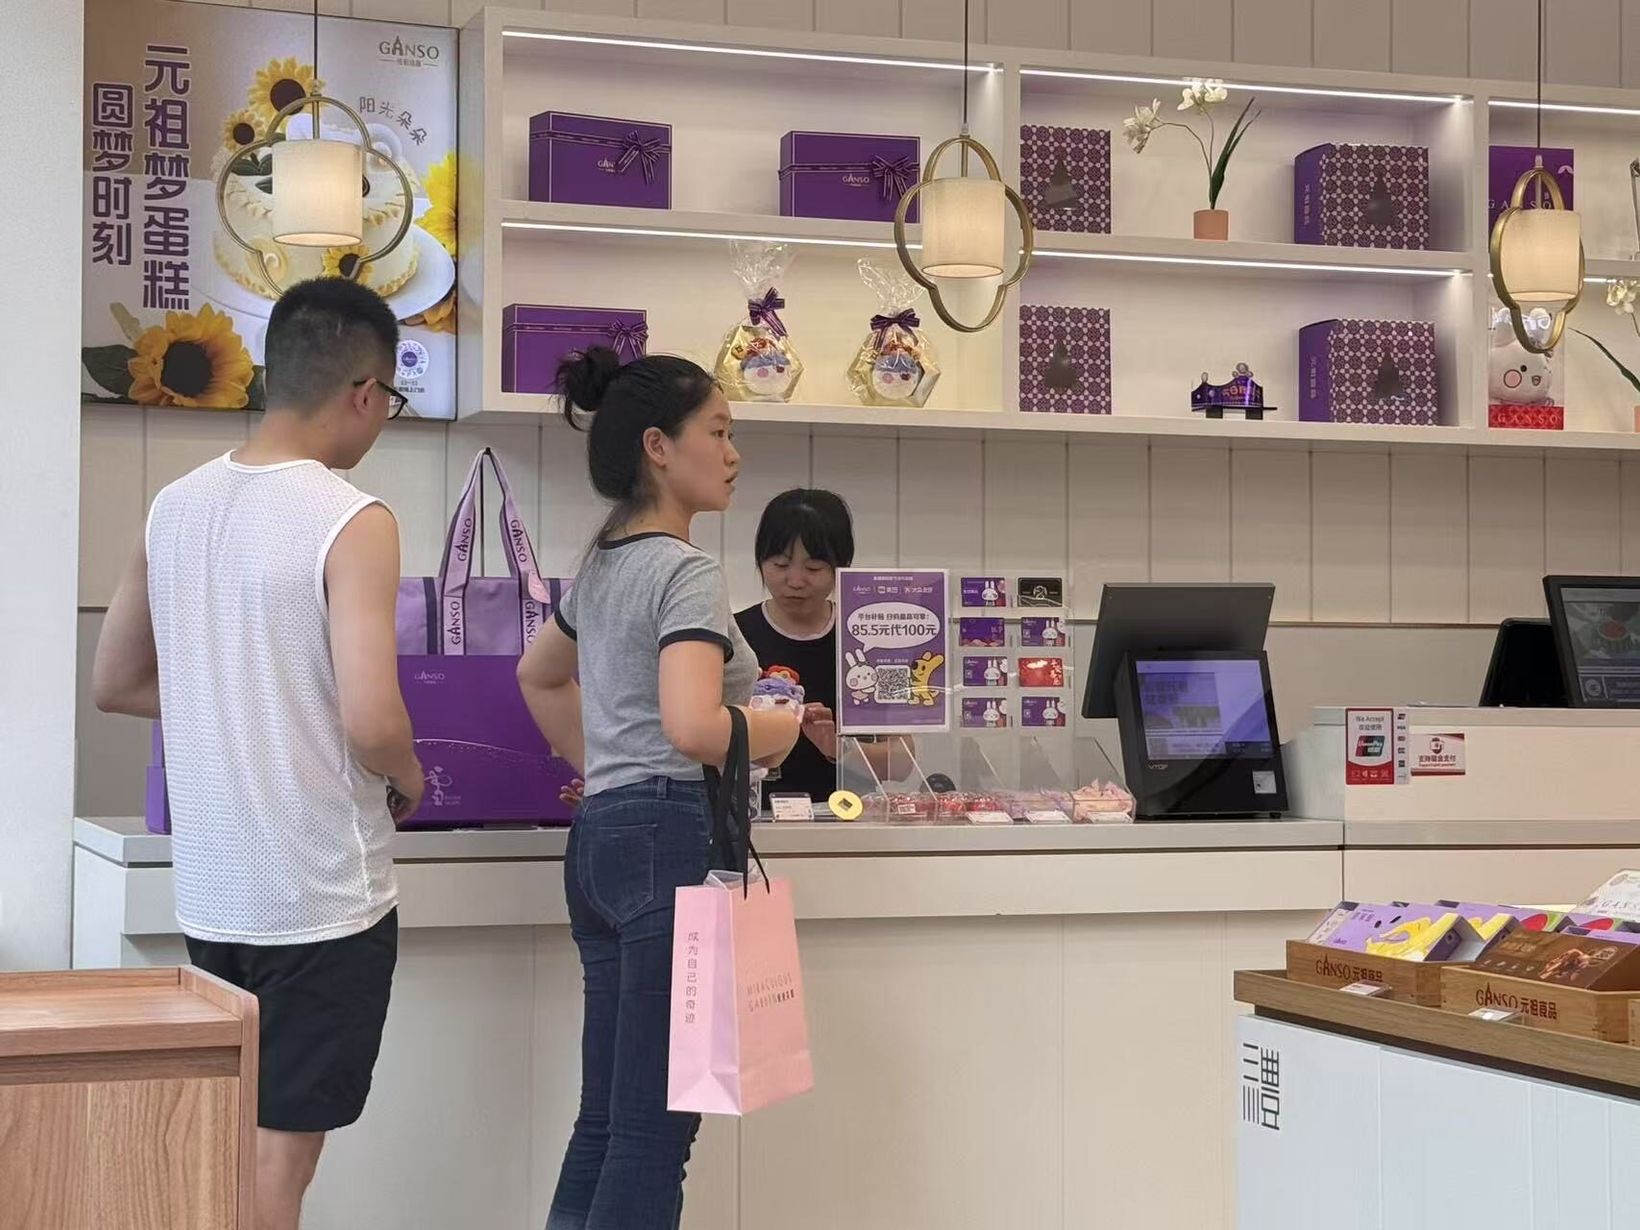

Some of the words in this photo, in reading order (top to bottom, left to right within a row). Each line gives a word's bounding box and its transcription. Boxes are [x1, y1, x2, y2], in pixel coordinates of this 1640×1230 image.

[379, 35, 440, 60] GANSO
[359, 96, 428, 146] 阳光朵朵
[92, 82, 134, 266] 圆梦时刻
[143, 44, 191, 311] 元祖梦蛋糕
[597, 157, 617, 169] GAN
[457, 517, 473, 563] GANSO
[510, 518, 528, 564] GANSO
[448, 600, 461, 646] GANSO
[851, 624, 937, 636] 85.5元代100元
[1315, 953, 1351, 980] GANSO
[1475, 981, 1519, 1009] GANSO
[1519, 996, 1558, 1020] 元祖食品
